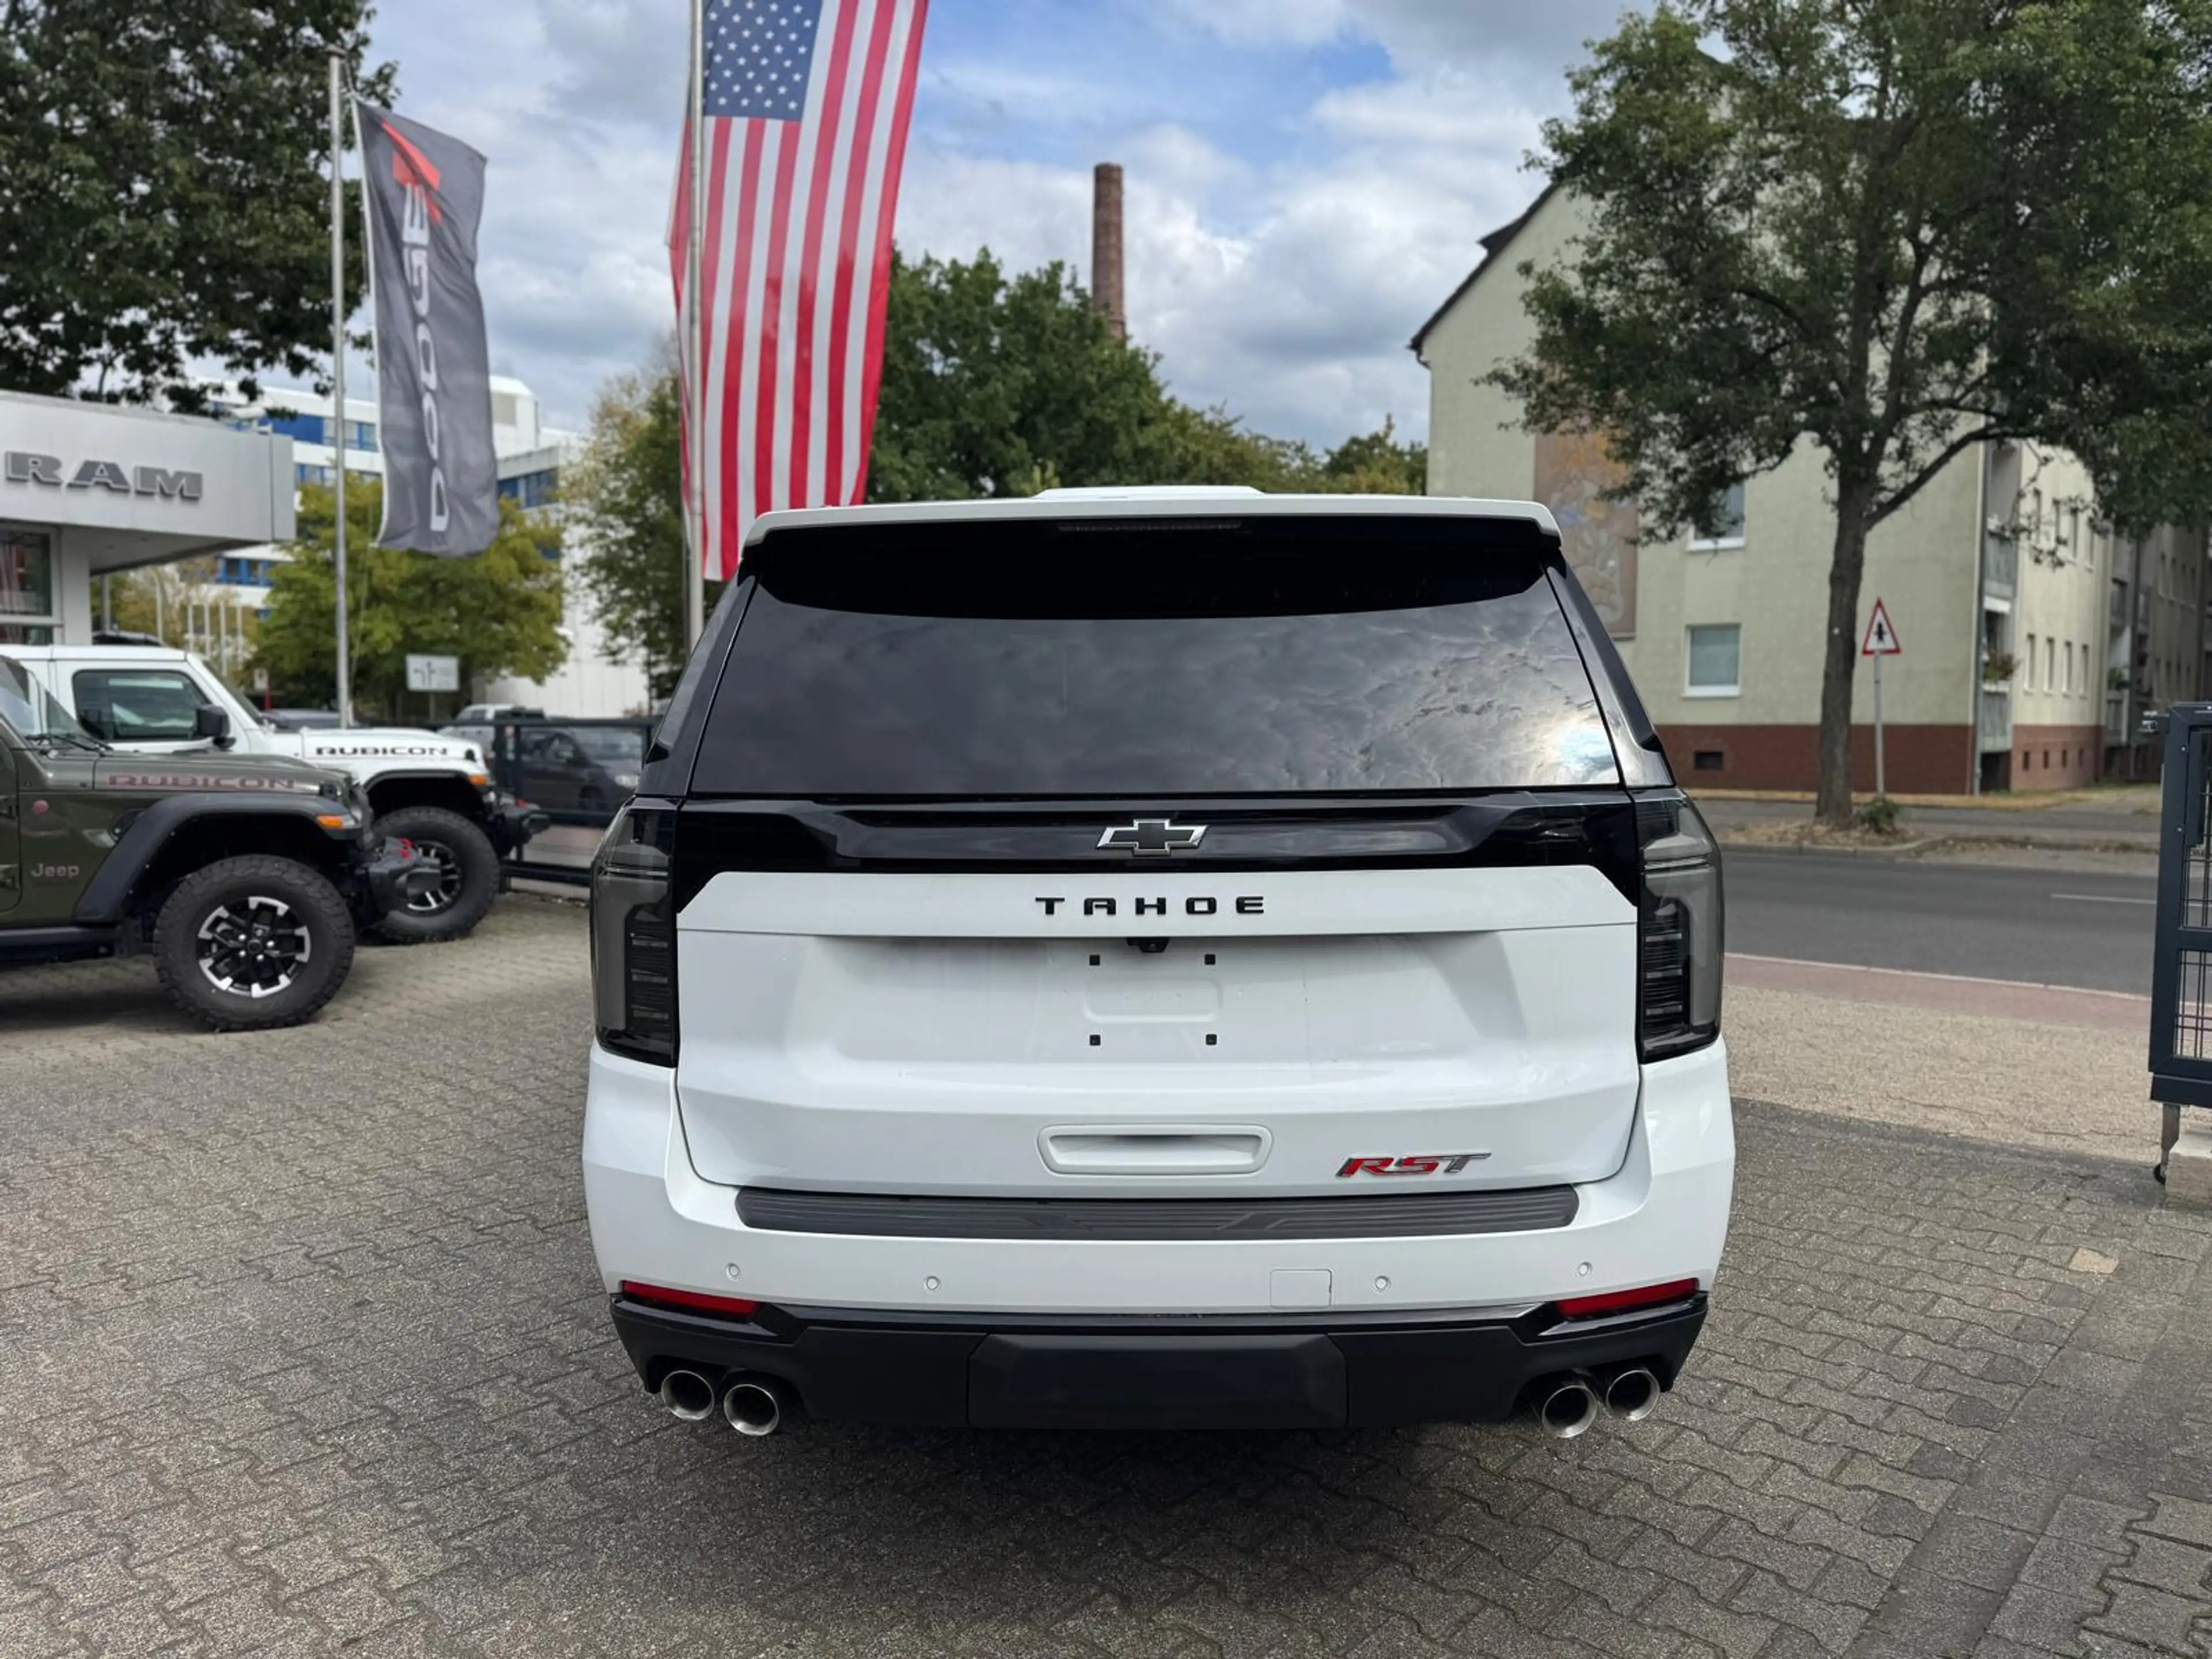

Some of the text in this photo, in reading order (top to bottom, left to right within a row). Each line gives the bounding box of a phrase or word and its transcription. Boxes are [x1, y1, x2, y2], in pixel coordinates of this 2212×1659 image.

[5, 451, 203, 501] RAM
[316, 746, 446, 756] RUBICON
[108, 774, 295, 789] RUBICON
[31, 862, 79, 878] Jeep
[1035, 896, 1265, 916] TAHOE
[1336, 1153, 1491, 1177] RST
